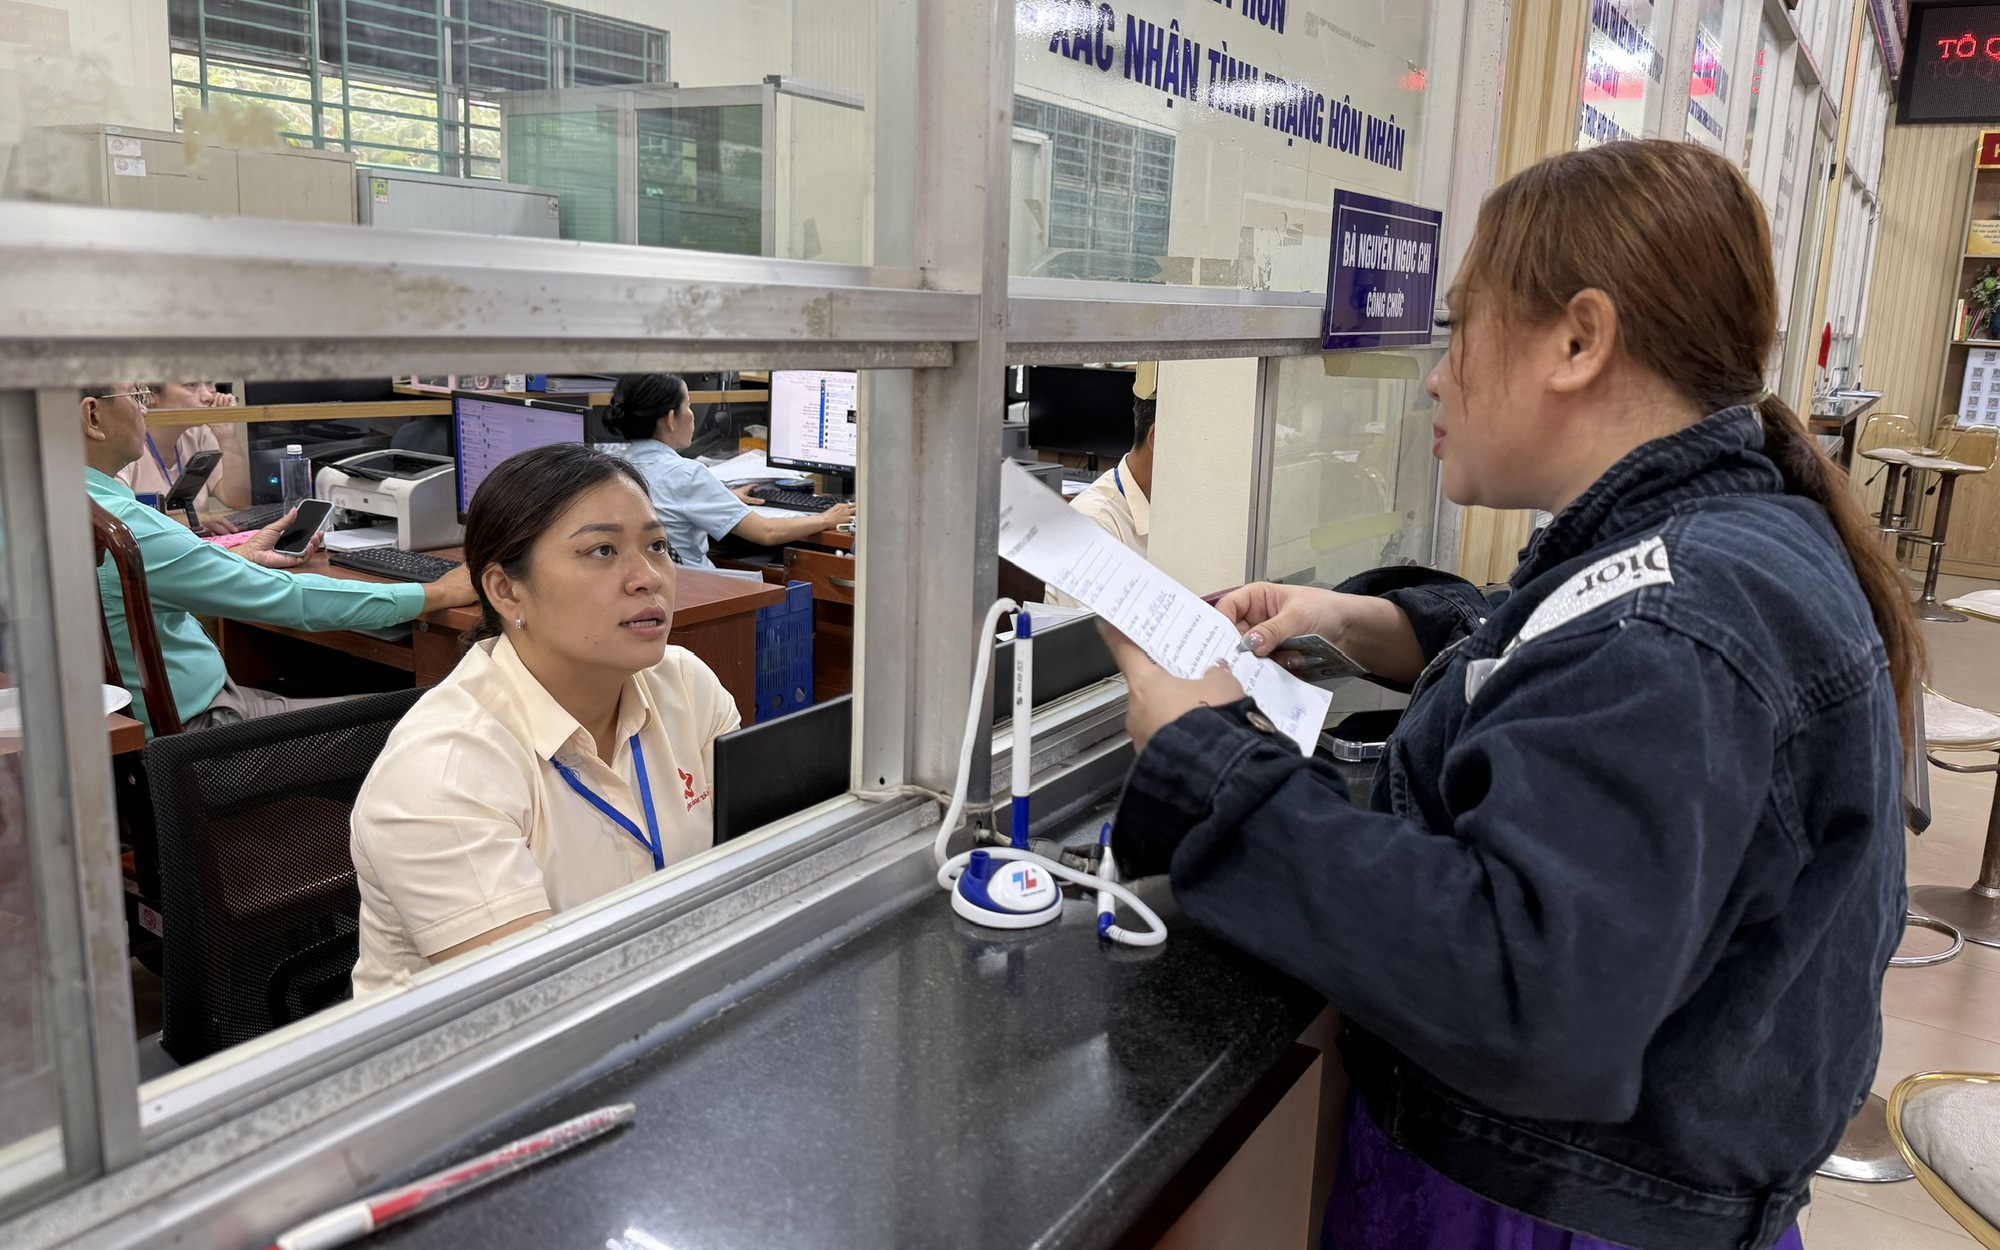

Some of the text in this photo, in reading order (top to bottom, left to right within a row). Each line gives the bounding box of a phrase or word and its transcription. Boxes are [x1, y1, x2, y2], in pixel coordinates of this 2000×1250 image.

[1124, 14, 1200, 108] NHẬN
[1327, 95, 1363, 157] HÔN
[1364, 114, 1405, 172] NHÂN
[1342, 225, 1431, 280] BÀ NGUYỄN NGỌC CHI
[1366, 287, 1405, 318] CÔNG CHỨC
[1577, 544, 1669, 596] Dior
